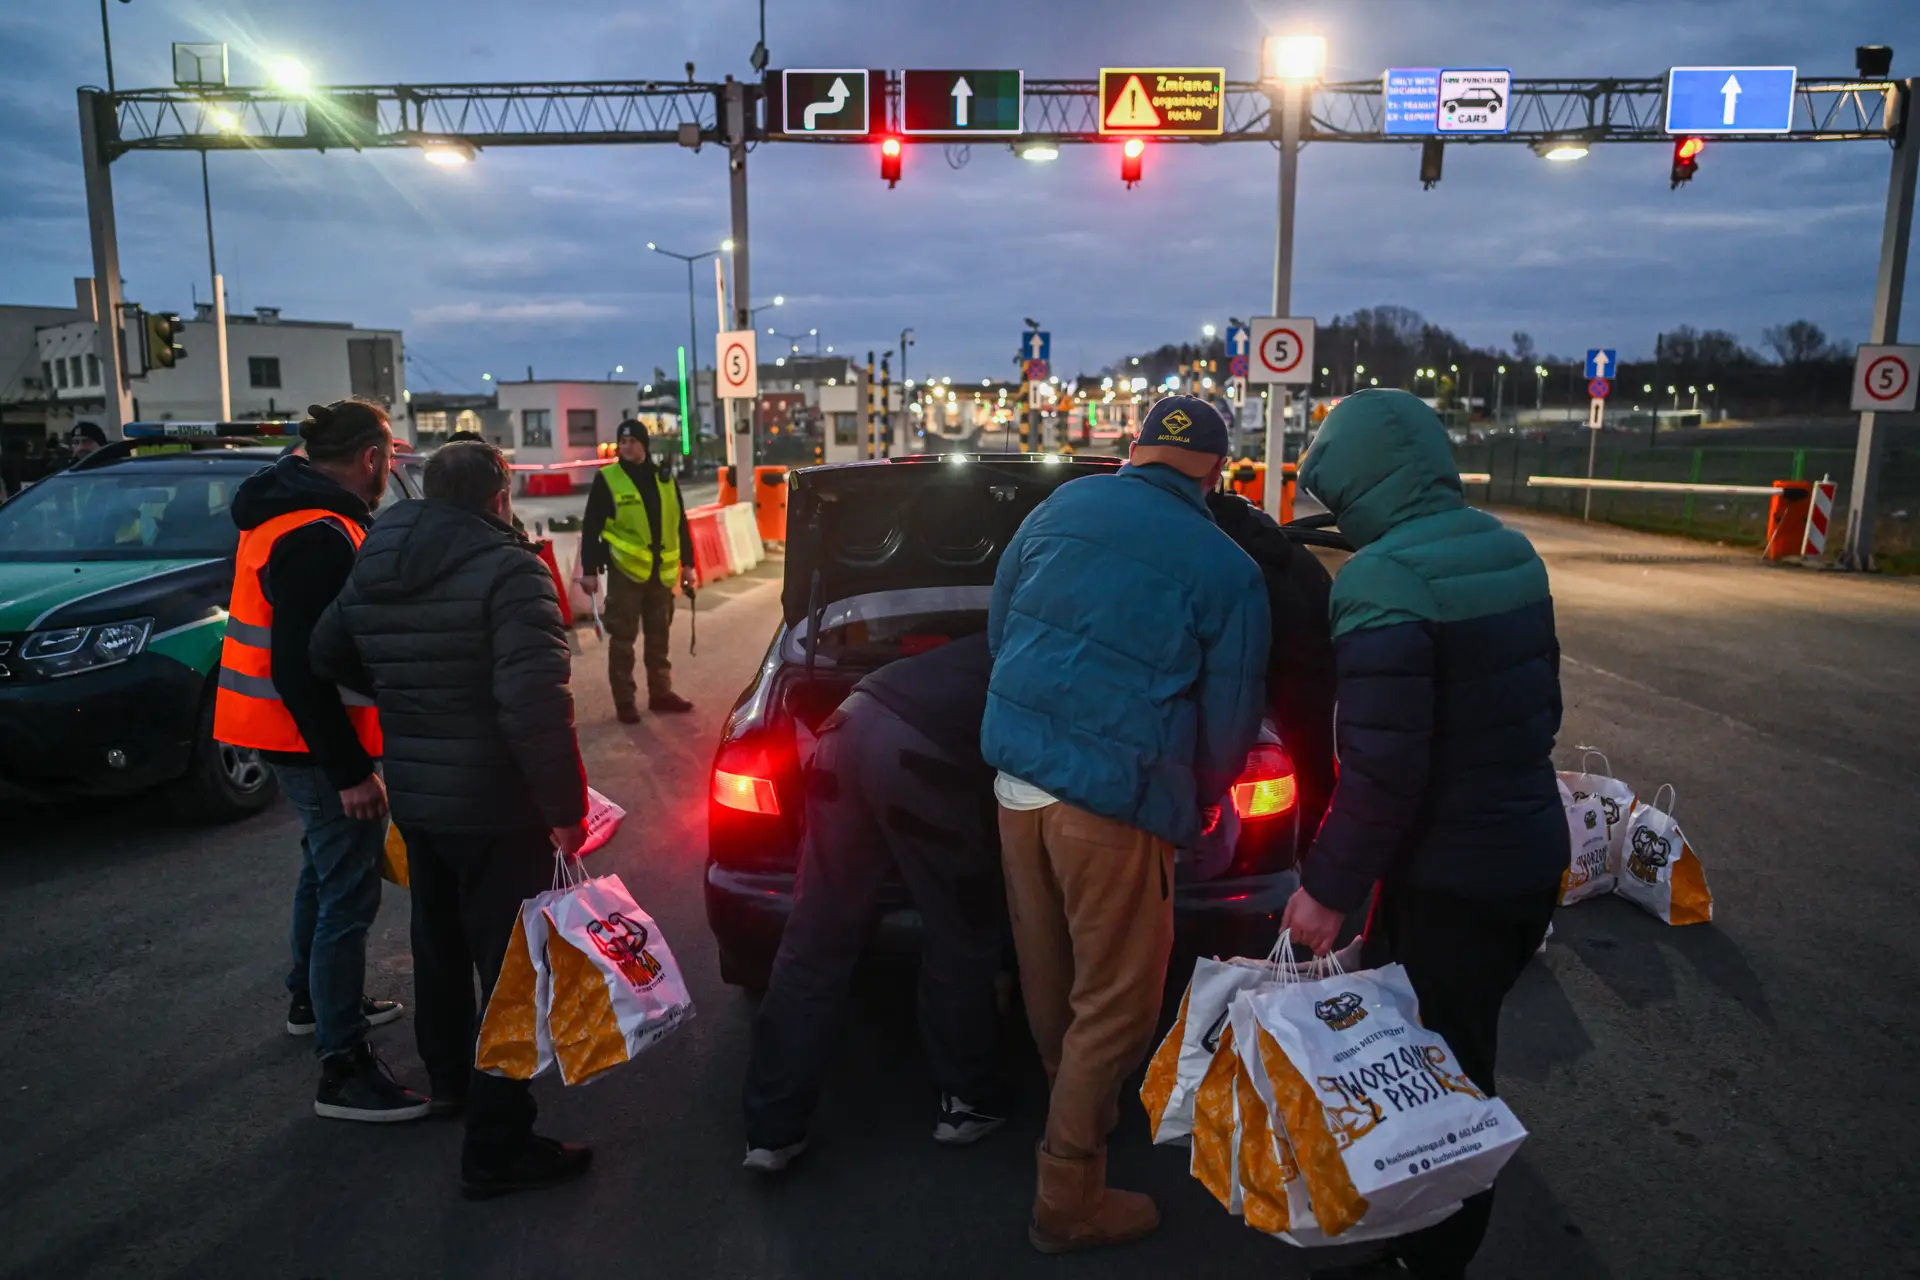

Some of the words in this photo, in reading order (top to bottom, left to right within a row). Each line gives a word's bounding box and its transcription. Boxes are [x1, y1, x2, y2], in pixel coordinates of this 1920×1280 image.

[1157, 76, 1212, 92] Zmiana
[1152, 94, 1218, 110] organizacji
[1168, 108, 1202, 121] ruchu
[1458, 114, 1488, 124] CARS
[1274, 340, 1288, 362] 5
[733, 355, 741, 376] 5
[1879, 367, 1893, 390] 5
[1157, 434, 1190, 443] AUSTRALIA
[1432, 1141, 1482, 1165] kuchniavikinga
